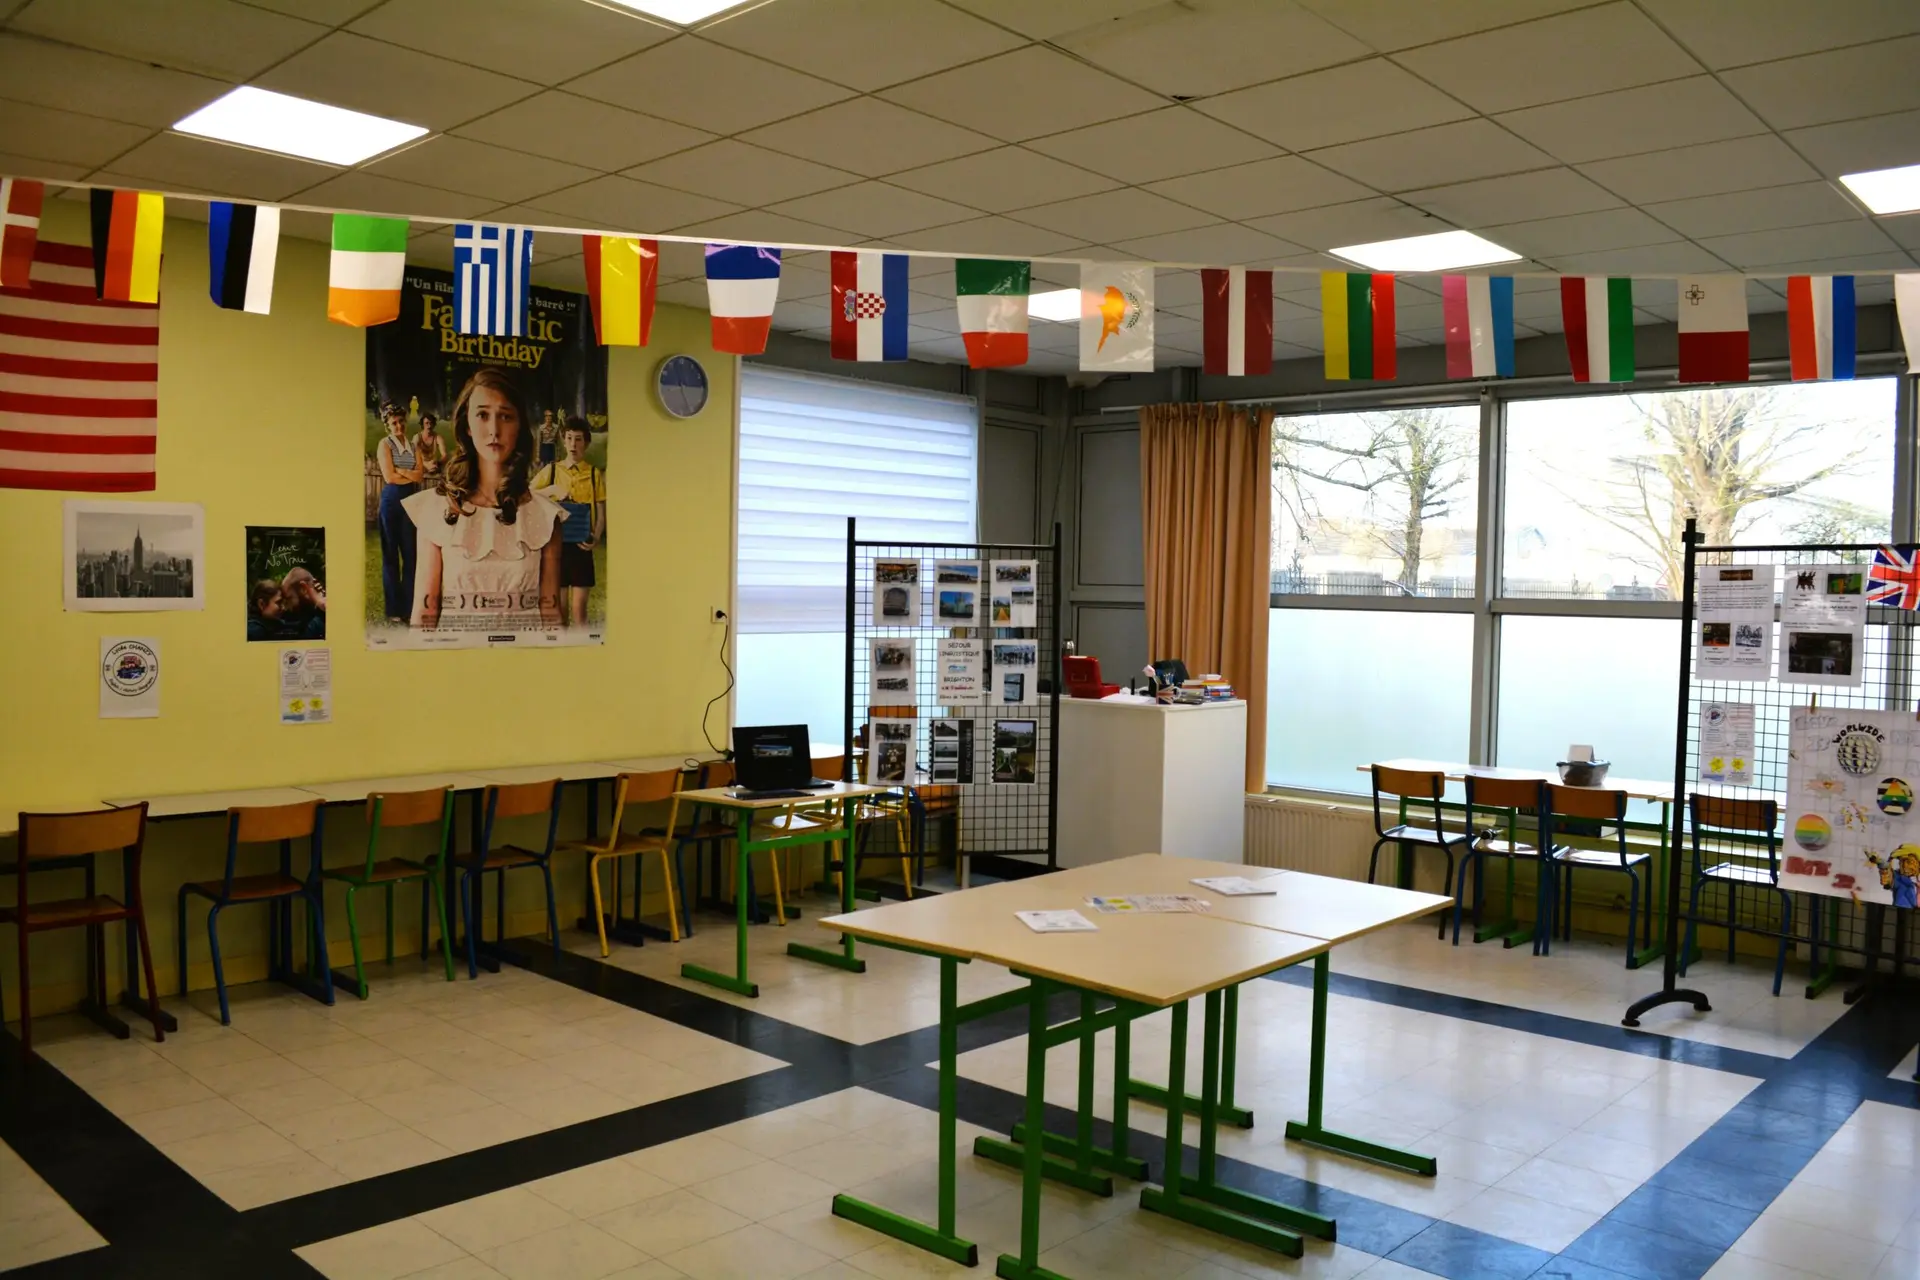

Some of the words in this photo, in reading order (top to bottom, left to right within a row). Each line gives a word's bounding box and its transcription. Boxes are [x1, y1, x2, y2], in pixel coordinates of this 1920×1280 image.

[535, 296, 564, 310] barré
[421, 294, 563, 344] Fatic
[440, 328, 546, 368] Birthday
[265, 555, 281, 570] No
[1832, 722, 1886, 745] WORLWIDE
